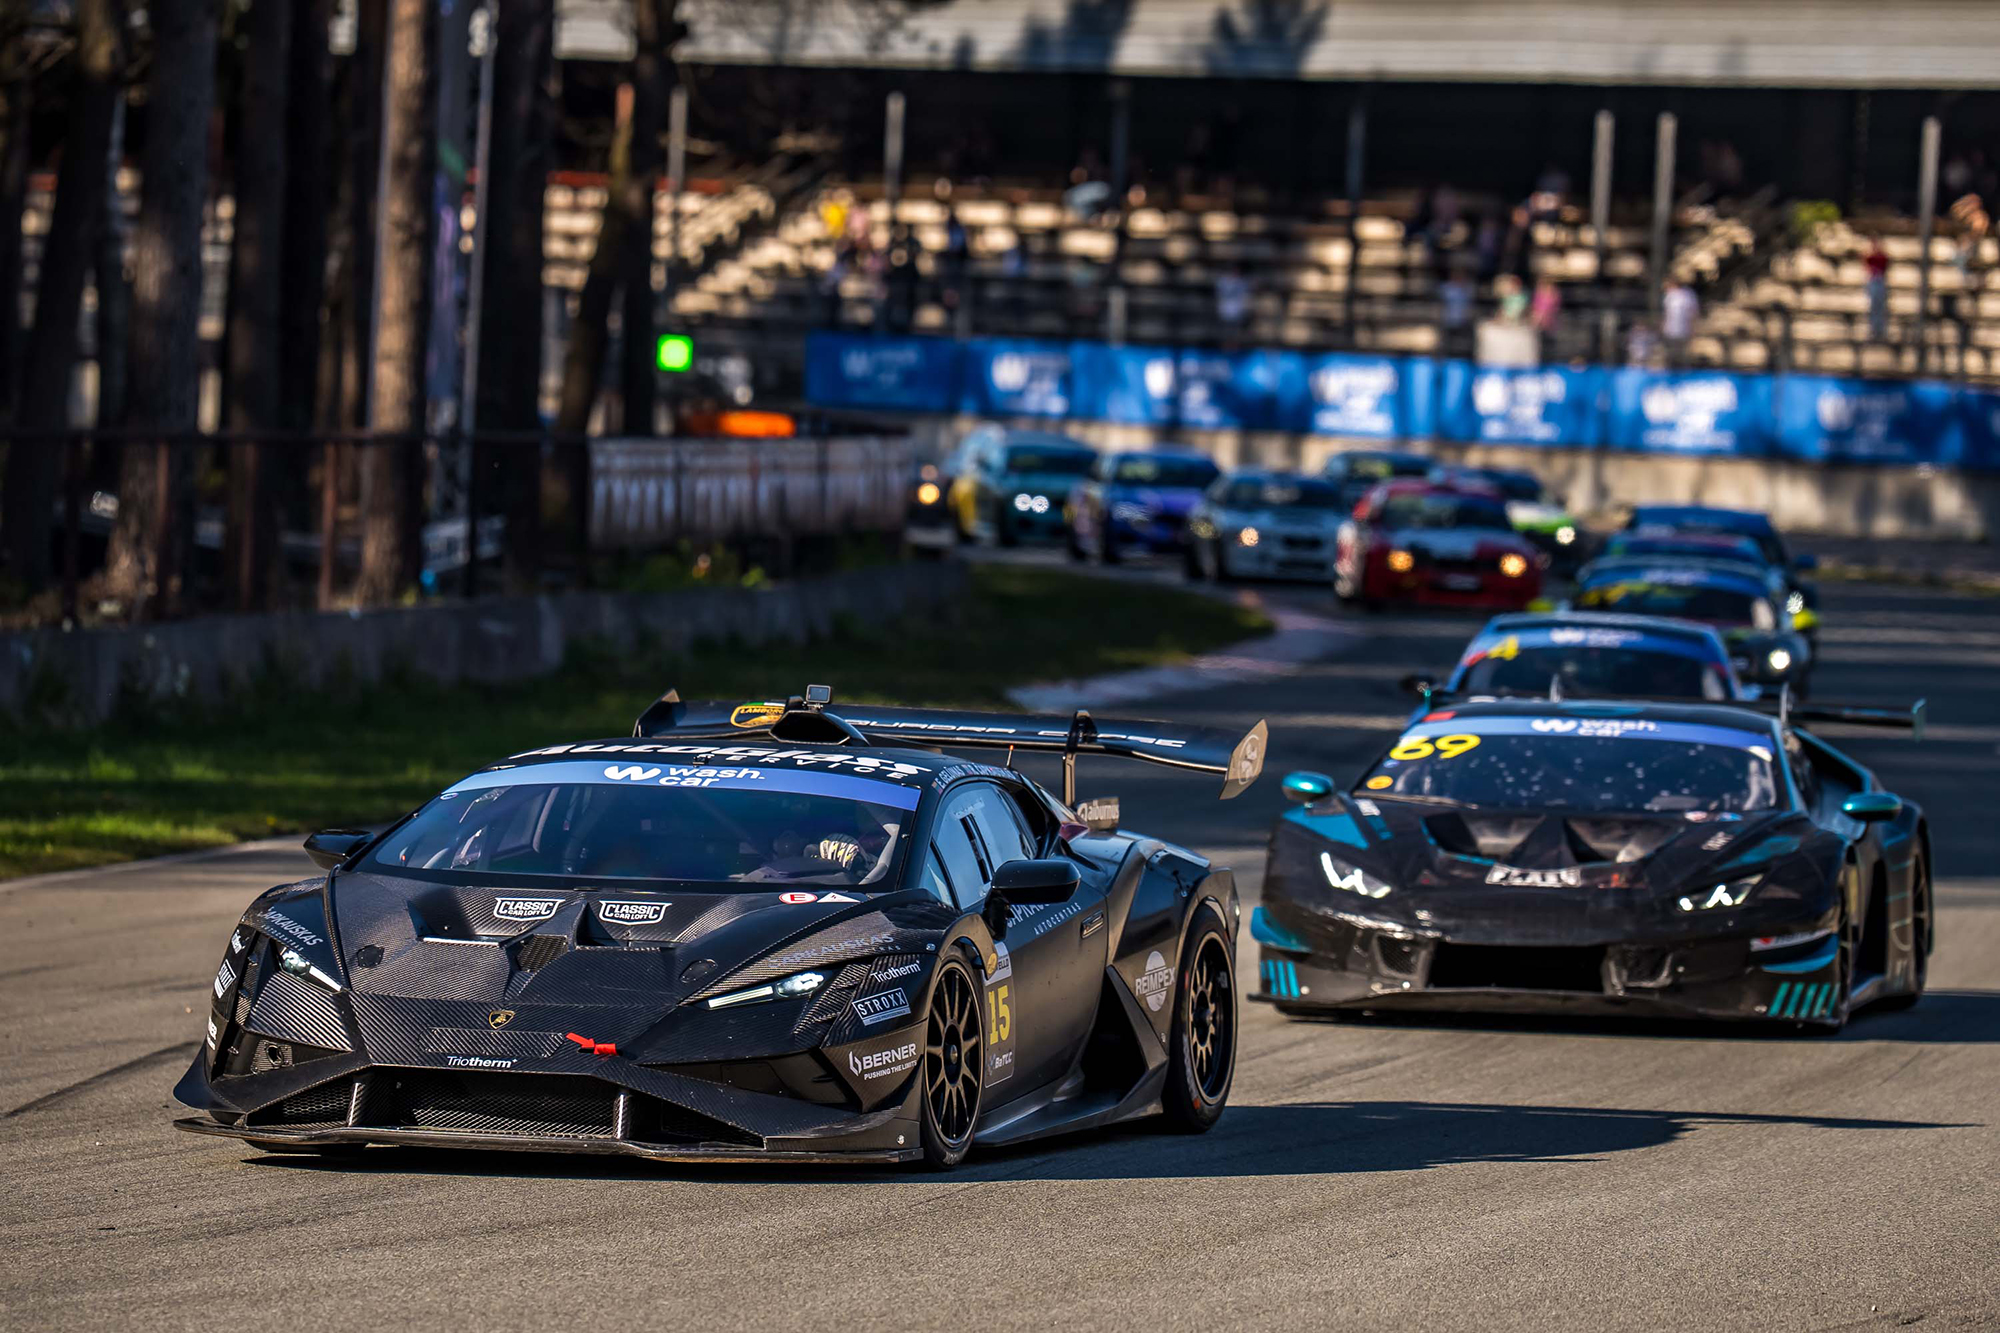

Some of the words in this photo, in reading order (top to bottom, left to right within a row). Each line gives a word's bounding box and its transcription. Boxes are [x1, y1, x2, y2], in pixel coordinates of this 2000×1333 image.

[1038, 730, 1187, 748] CRSE
[1389, 733, 1481, 761] 69
[658, 776, 721, 787] car
[499, 901, 554, 915] CLASSIC
[604, 904, 661, 920] CLASSIC
[1034, 902, 1082, 936] AUTOCENTRAS
[1135, 967, 1176, 996] REIMPEX
[857, 991, 906, 1016] STROXX
[988, 984, 1011, 1045] 15
[863, 1042, 917, 1070] BERNER
[864, 1068, 891, 1080] PUSHING
[891, 1064, 903, 1074] THE
